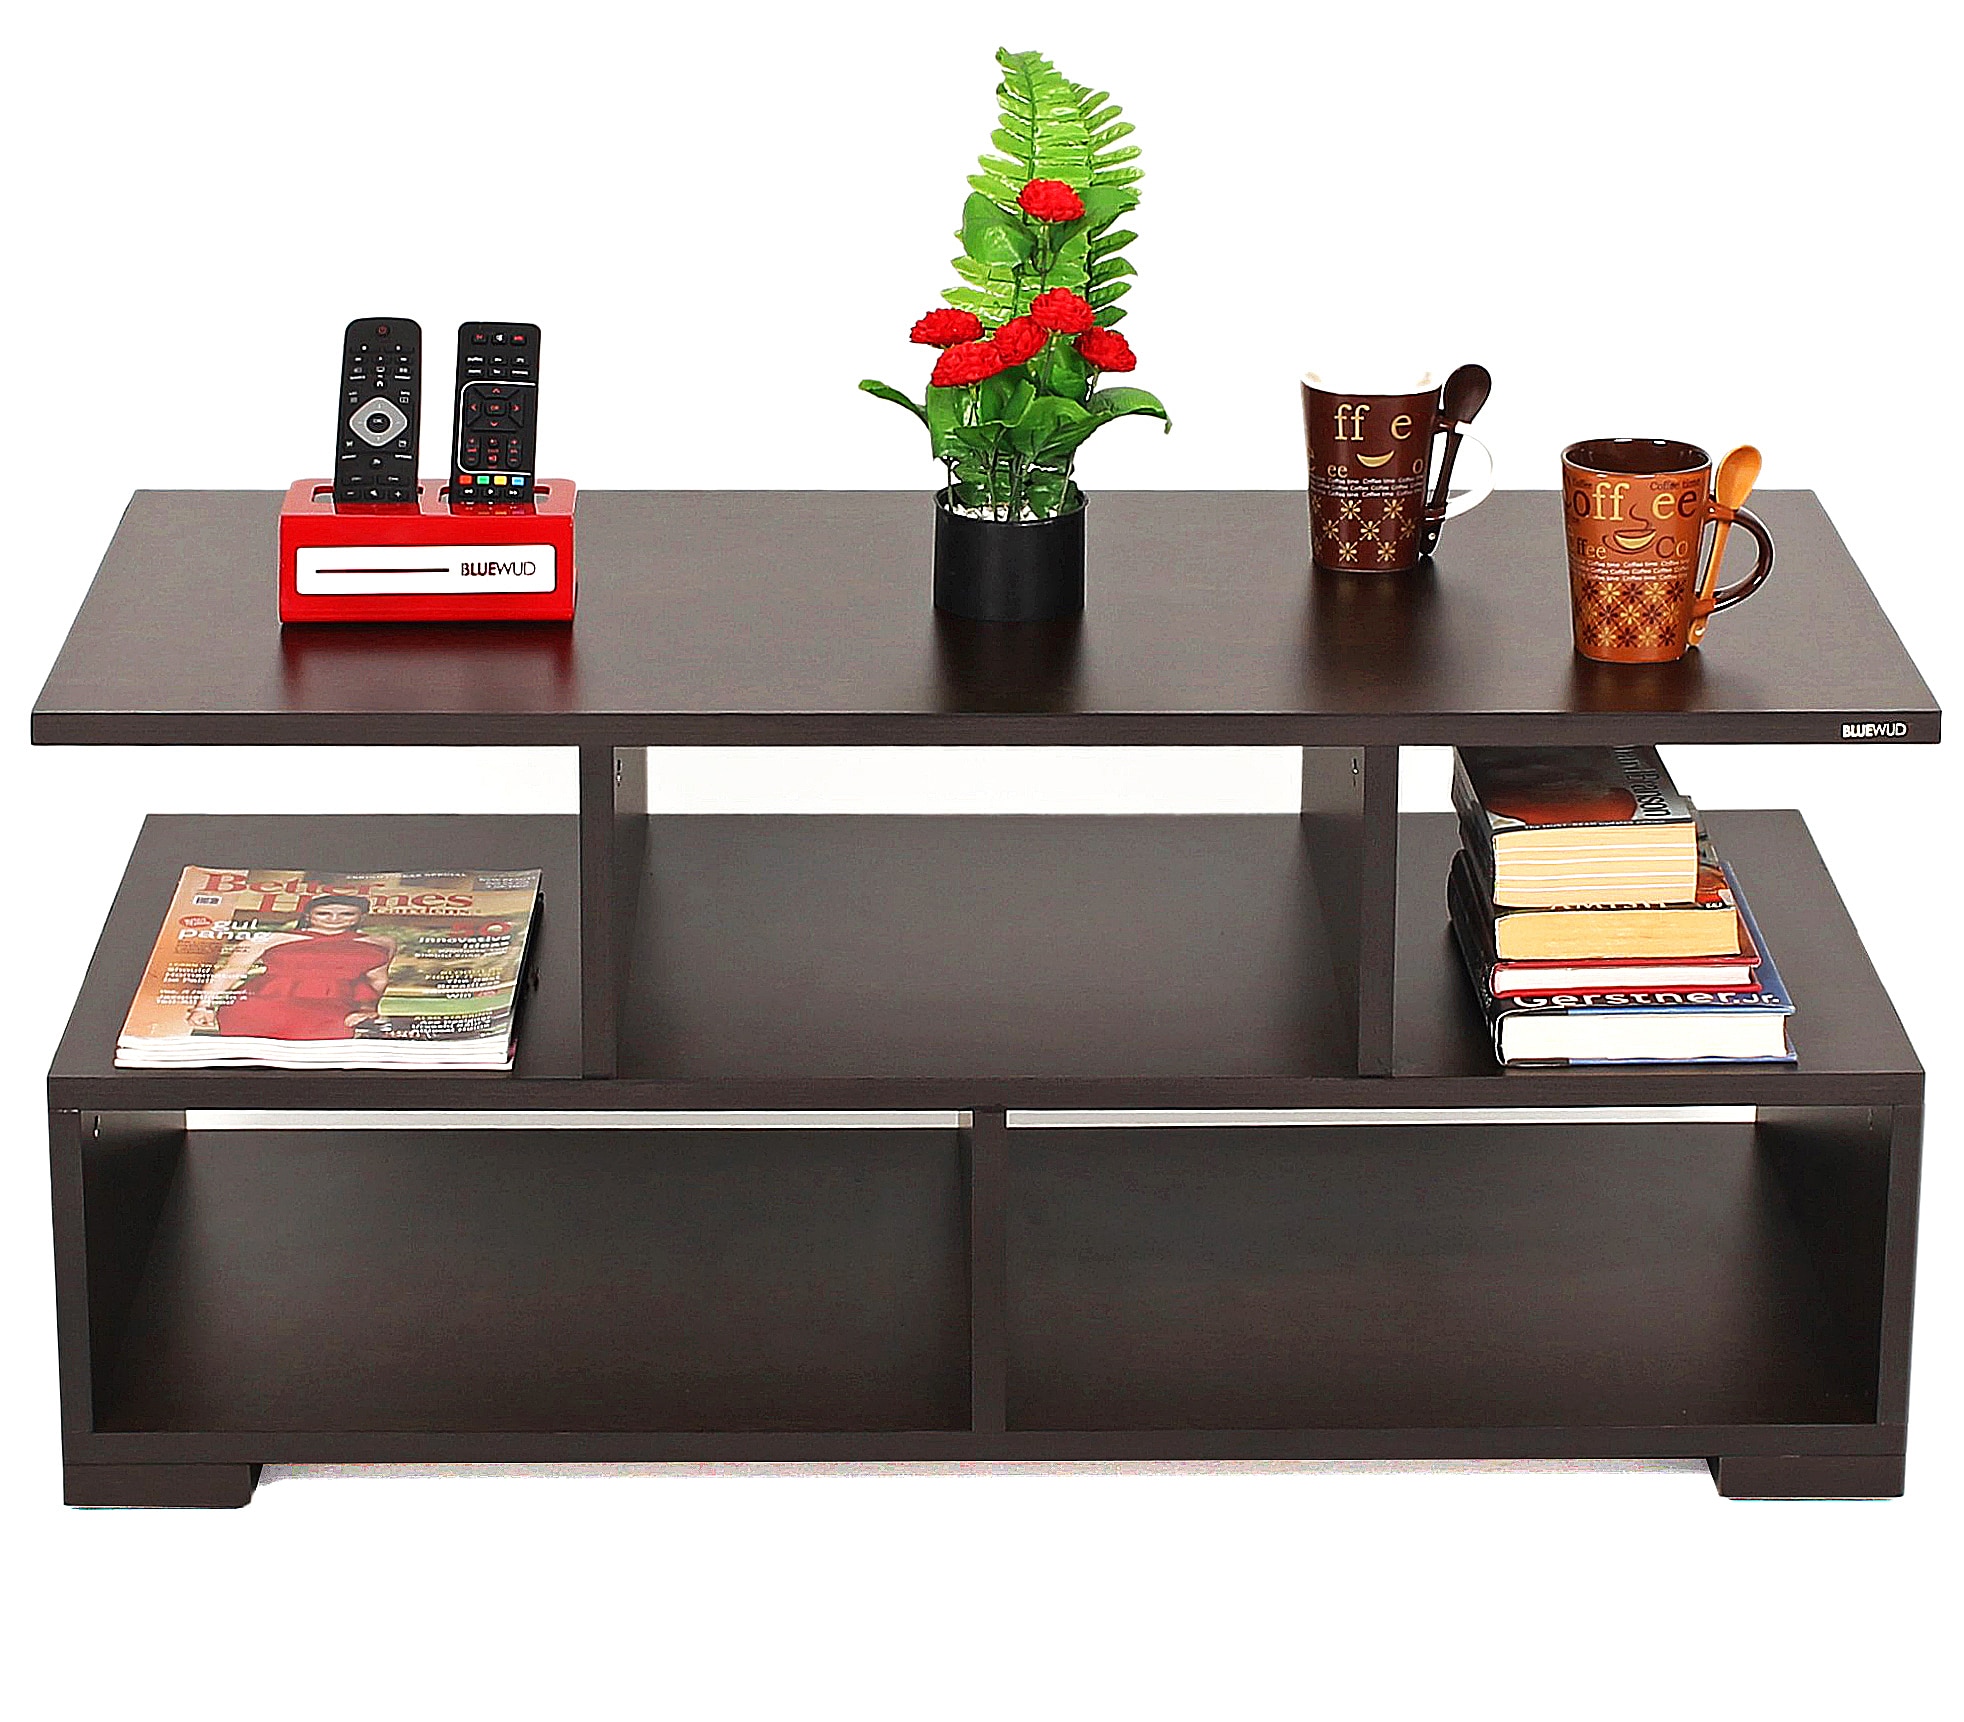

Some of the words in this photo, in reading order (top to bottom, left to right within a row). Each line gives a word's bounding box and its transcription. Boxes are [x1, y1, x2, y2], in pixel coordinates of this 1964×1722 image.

[461, 561, 536, 576] BLUEWUD
[1842, 722, 1907, 738] BLUEWUD
[203, 873, 386, 897] Better
[259, 893, 473, 913] Hmes
